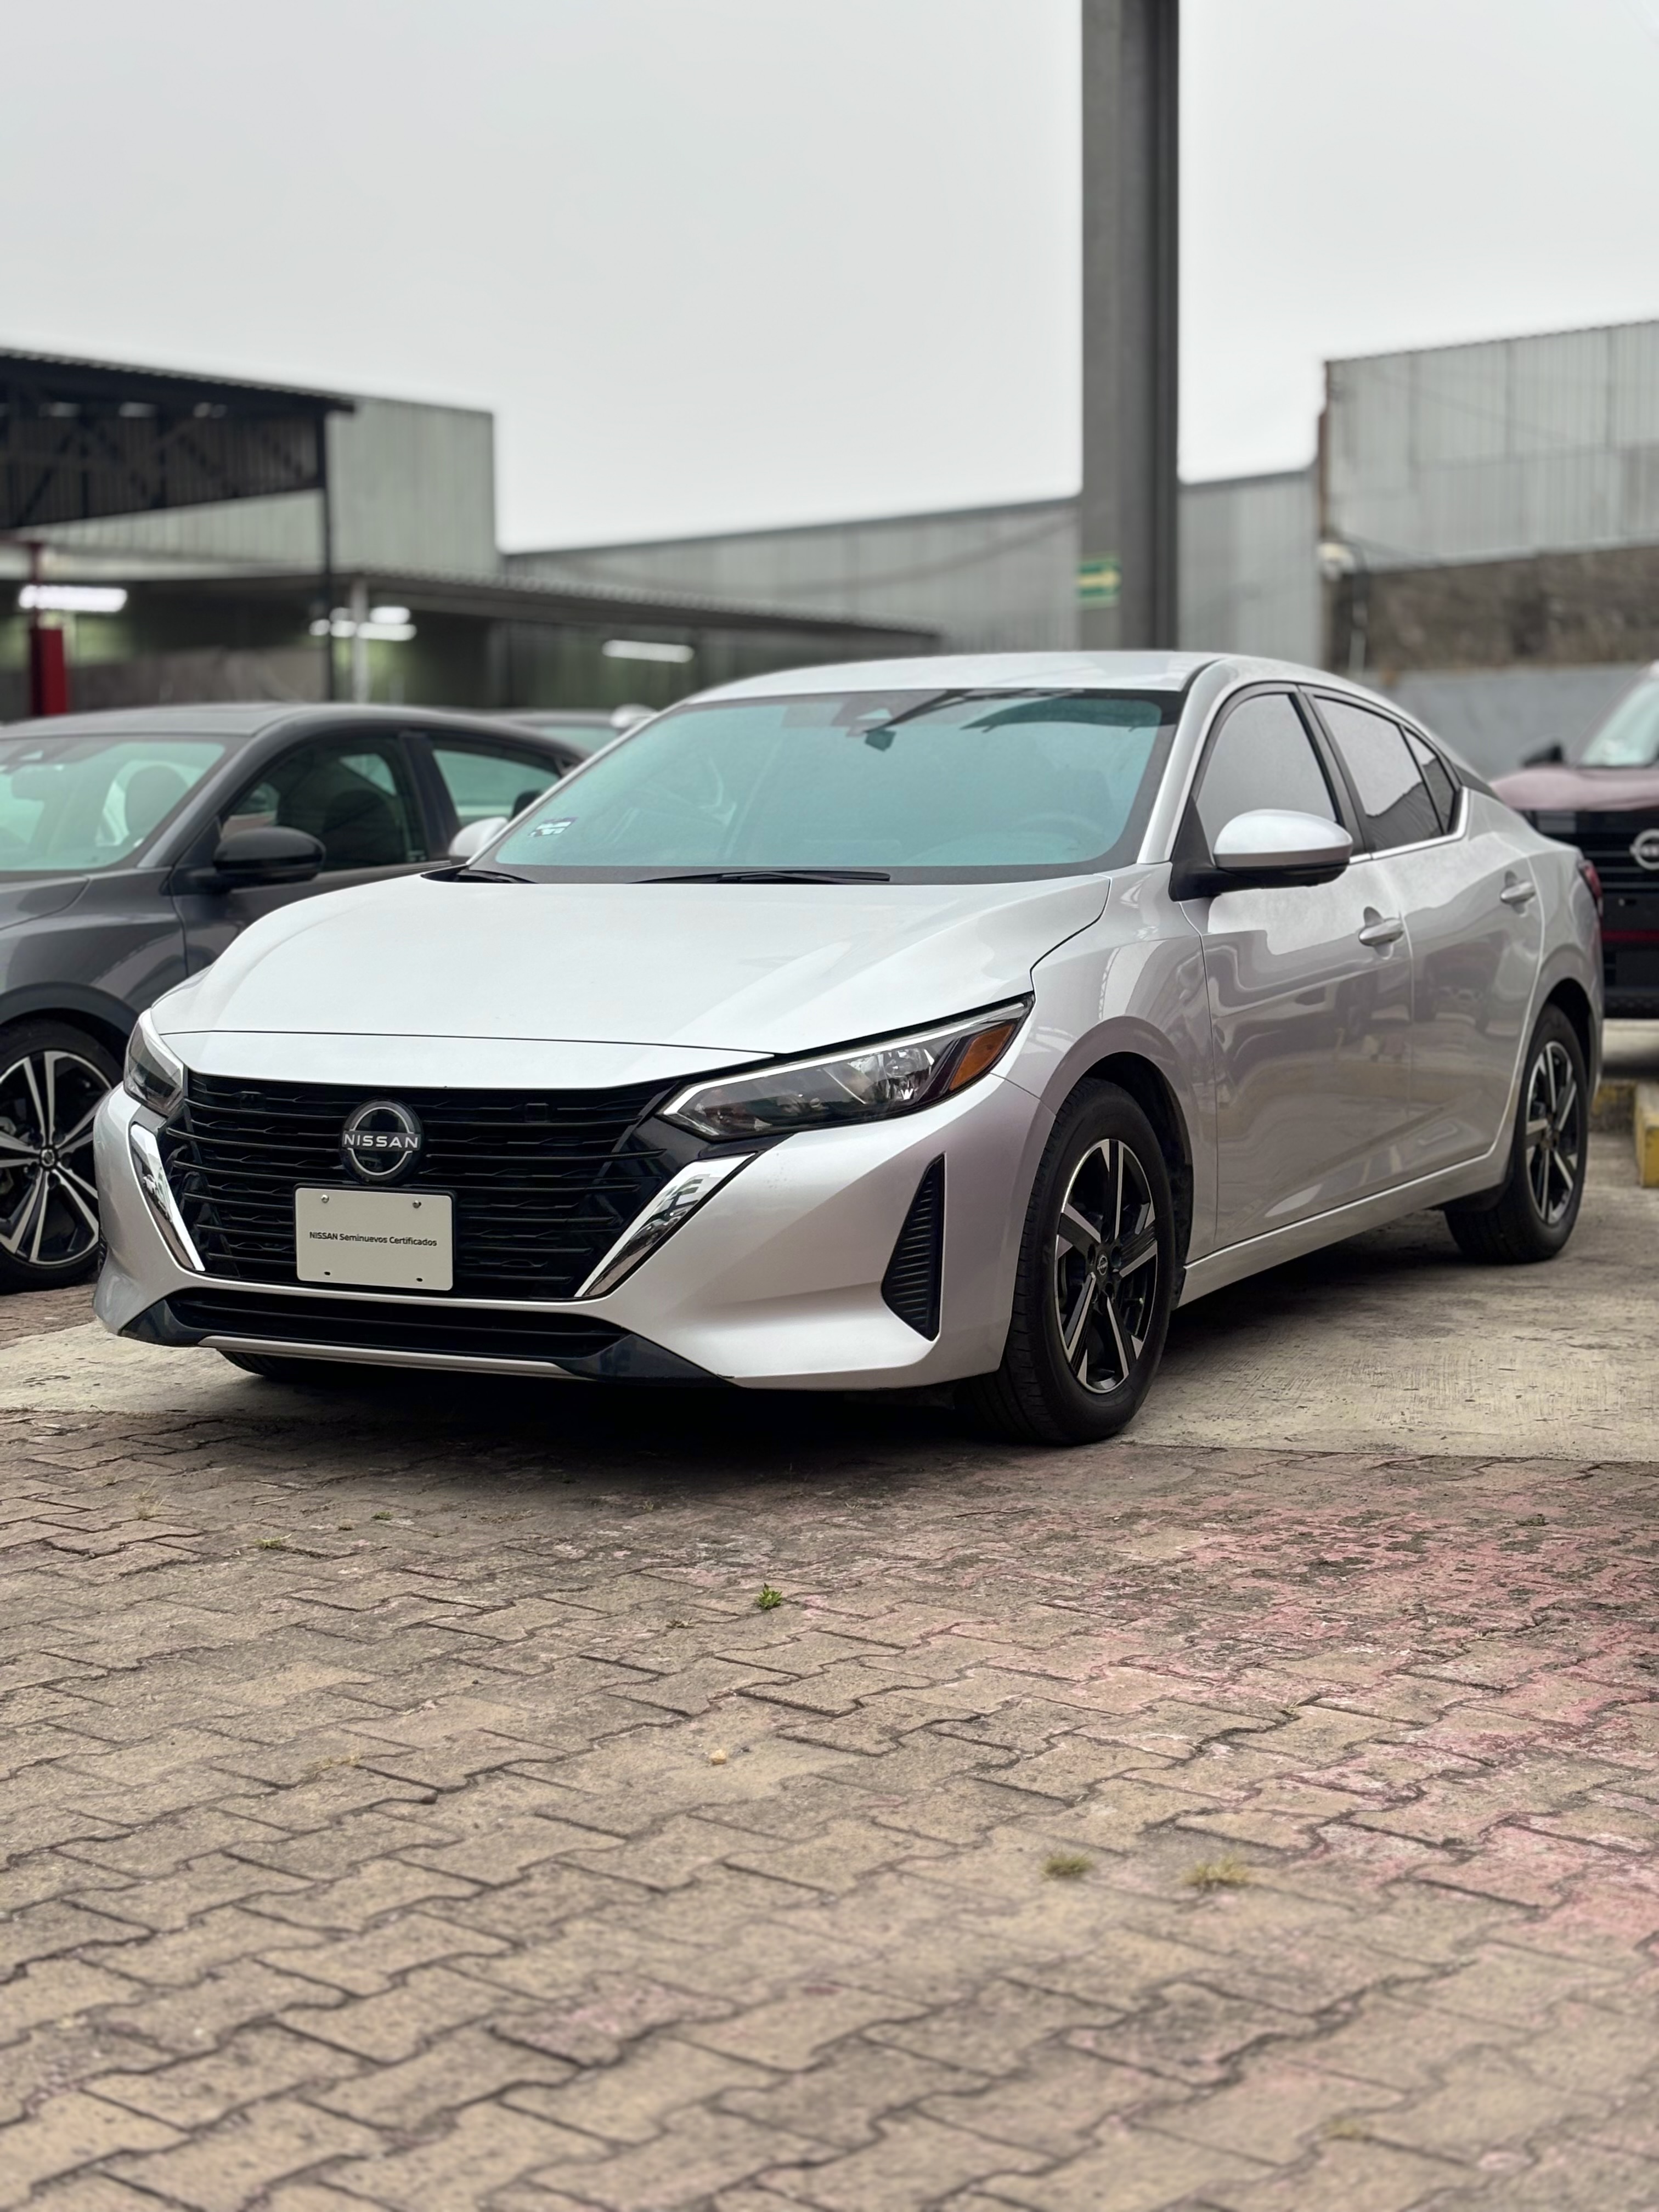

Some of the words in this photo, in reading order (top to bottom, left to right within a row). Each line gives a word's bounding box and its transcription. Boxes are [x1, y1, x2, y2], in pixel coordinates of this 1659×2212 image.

[344, 1133, 418, 1148] NISSAN
[309, 1231, 338, 1240] NISSAN
[339, 1233, 388, 1244] Seminuevos
[389, 1236, 438, 1246] Certificados
